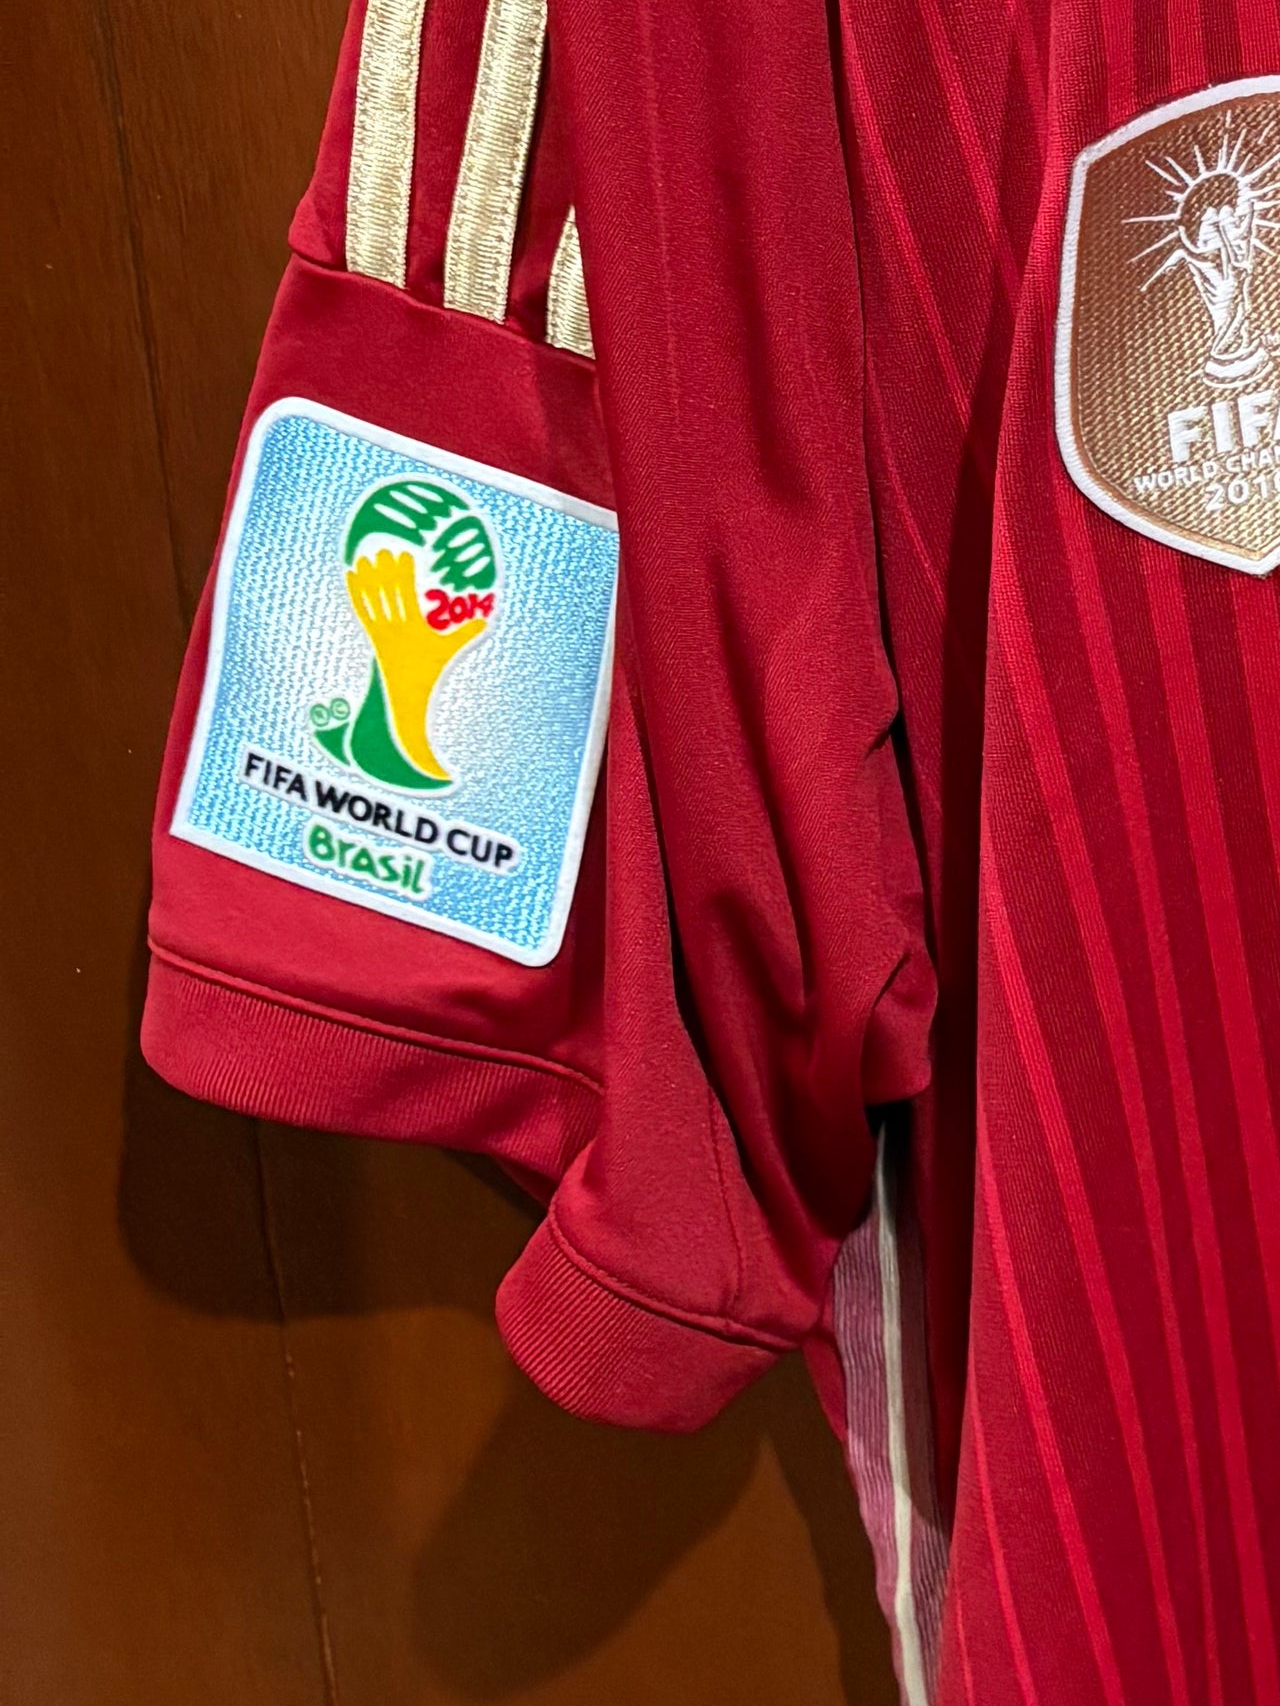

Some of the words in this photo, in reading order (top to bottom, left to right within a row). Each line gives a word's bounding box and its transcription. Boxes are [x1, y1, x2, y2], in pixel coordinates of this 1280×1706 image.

[1133, 459, 1220, 494] WORLD
[424, 588, 496, 631] 2014
[243, 752, 308, 803] FIFA
[313, 780, 439, 845] WORLD
[446, 828, 514, 869] CUP
[308, 823, 426, 894] Brasil
